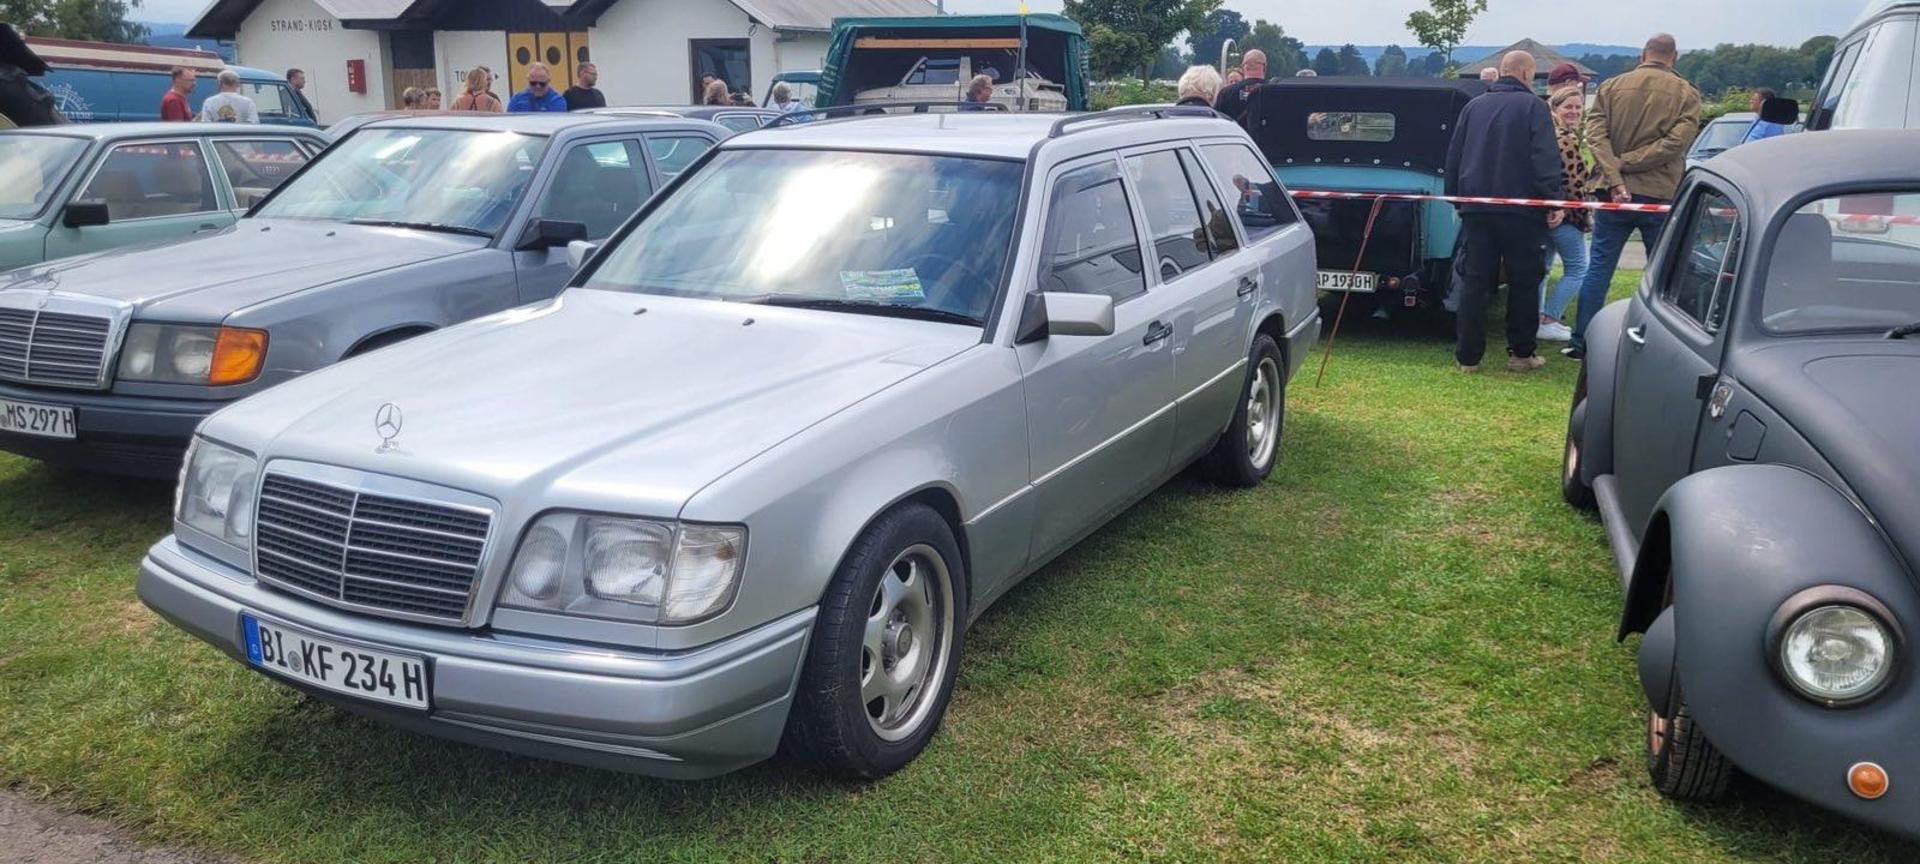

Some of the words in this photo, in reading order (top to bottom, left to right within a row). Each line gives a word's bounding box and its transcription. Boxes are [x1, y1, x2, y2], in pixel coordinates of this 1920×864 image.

[271, 19, 333, 32] STRAND-KIOSK
[6, 403, 27, 429] MS
[259, 625, 288, 668] BI
[301, 640, 334, 681] KF
[341, 651, 397, 696] 234
[402, 661, 424, 701] H
